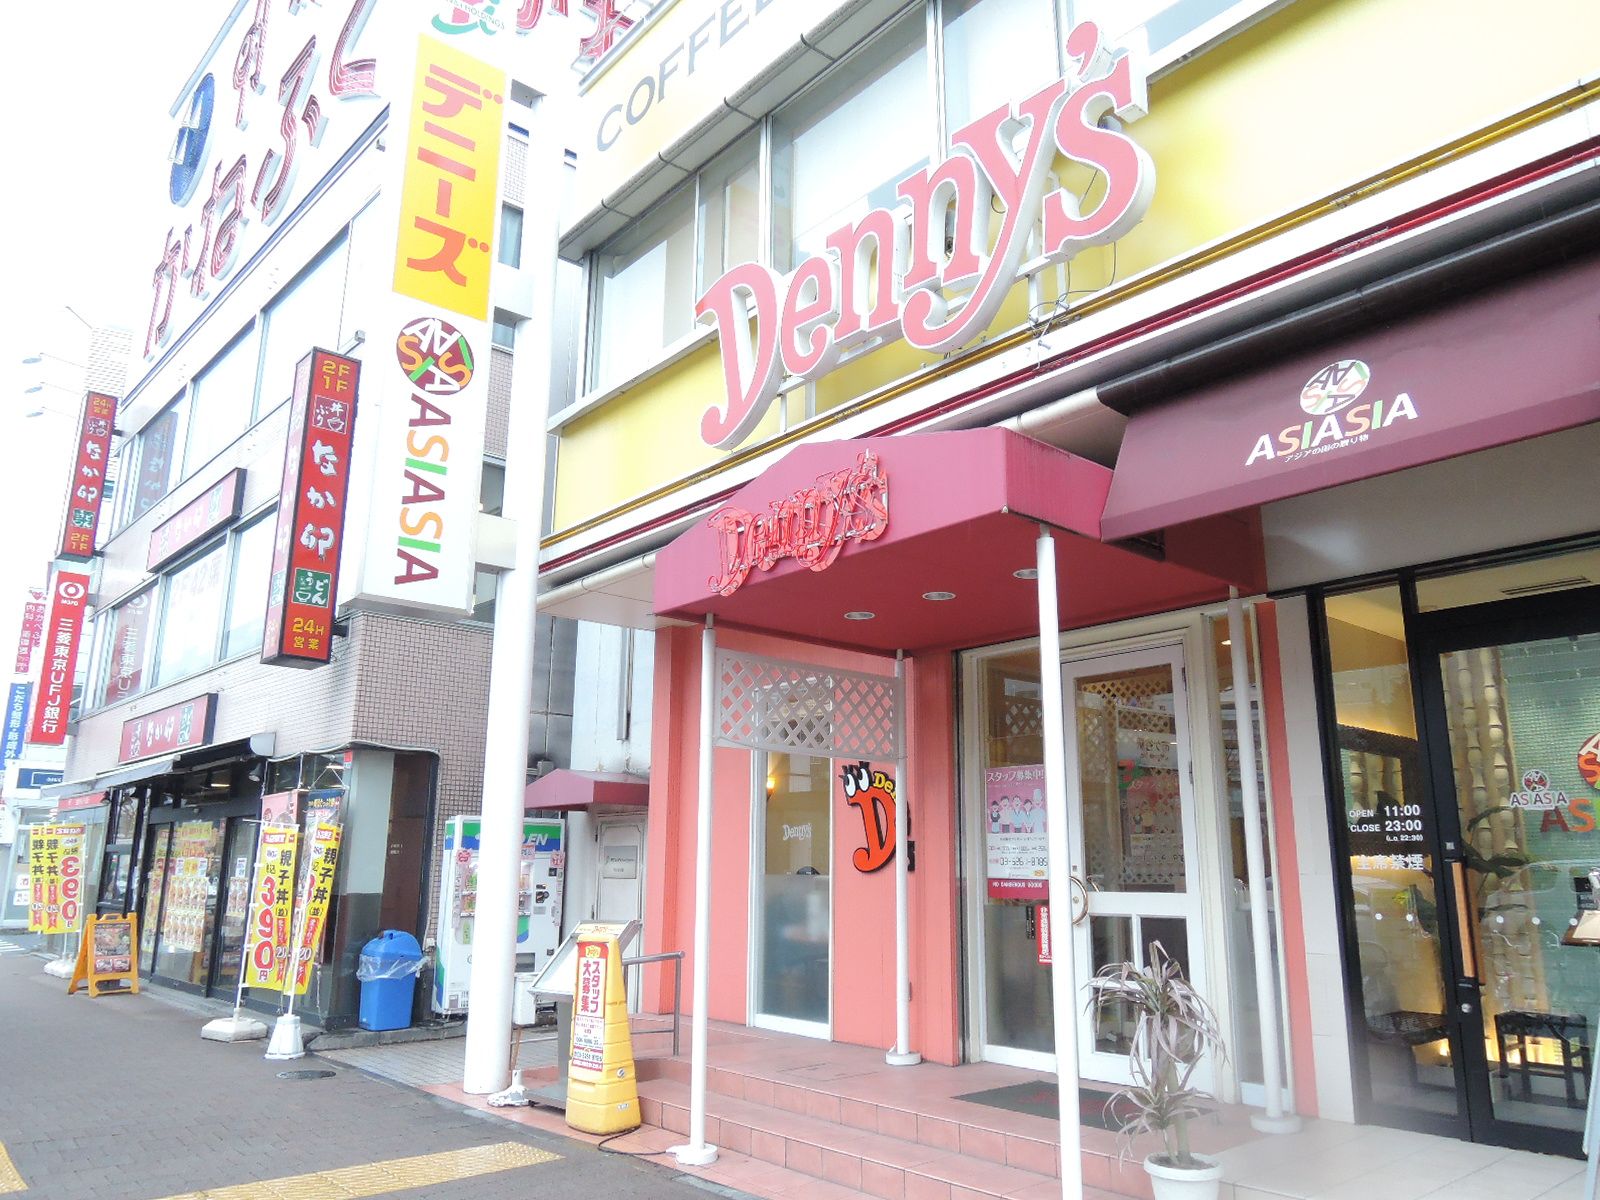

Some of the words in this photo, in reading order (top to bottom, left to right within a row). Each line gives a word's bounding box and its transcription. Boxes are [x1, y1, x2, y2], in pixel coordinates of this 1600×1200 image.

[465, 5, 506, 30] HOLDINGS
[405, 63, 504, 288] デニーズ
[696, 20, 1152, 448] Denny's
[321, 359, 349, 376] 2F
[322, 375, 348, 393] 1F
[1245, 392, 1419, 466] ASIASIA
[300, 439, 340, 561] なか卯
[394, 393, 451, 585] ASIASIA
[707, 447, 888, 597] Denny's
[292, 617, 325, 636] 24H
[293, 636, 320, 651] 営業
[41, 618, 74, 734] 三菱東京UFJ銀行
[782, 822, 813, 841] Denny's
[1348, 809, 1375, 818] OPEN
[1383, 804, 1421, 817] 11:00
[1349, 824, 1381, 832] CLOSE
[1385, 820, 1423, 832] 23:00
[275, 848, 293, 906] 親子丼
[313, 847, 337, 904] 親子丼
[580, 960, 591, 1013] 大募集
[590, 960, 601, 1014] スタッフ
